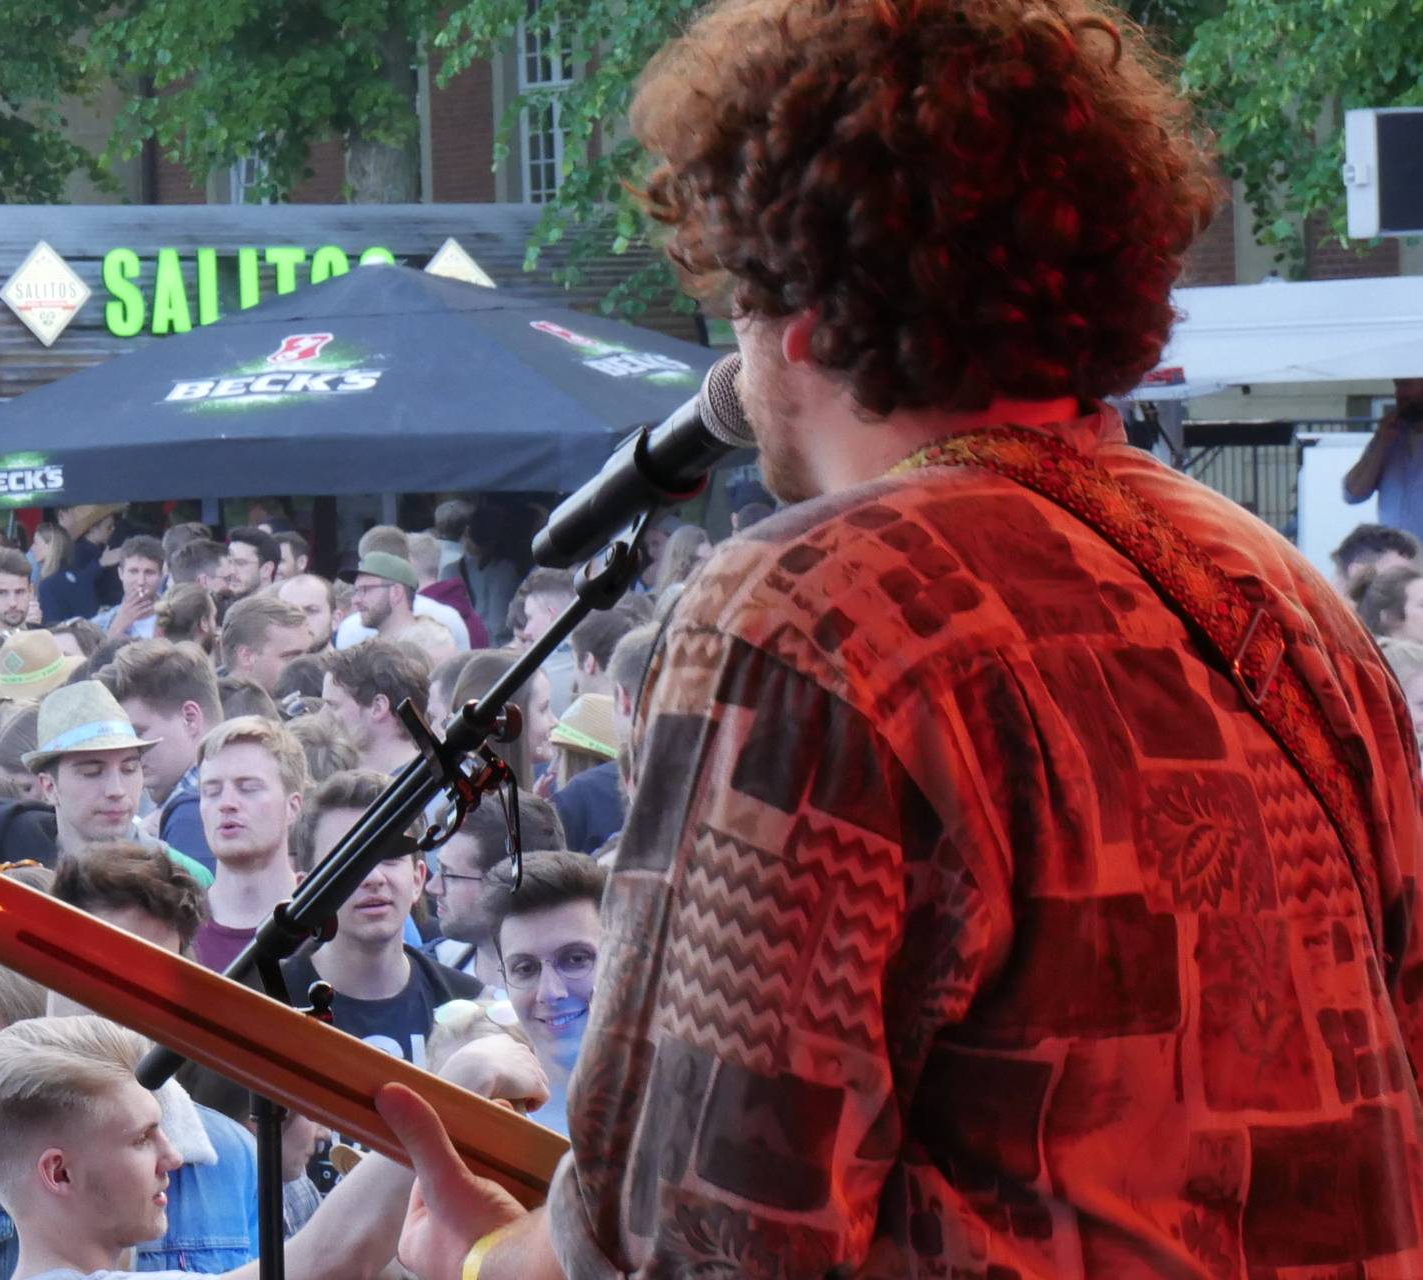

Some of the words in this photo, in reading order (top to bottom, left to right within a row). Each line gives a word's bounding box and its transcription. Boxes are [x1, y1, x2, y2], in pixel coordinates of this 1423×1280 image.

[15, 282, 77, 299] SALITOS
[102, 246, 395, 337] SALIT
[165, 369, 382, 401] BECK'S
